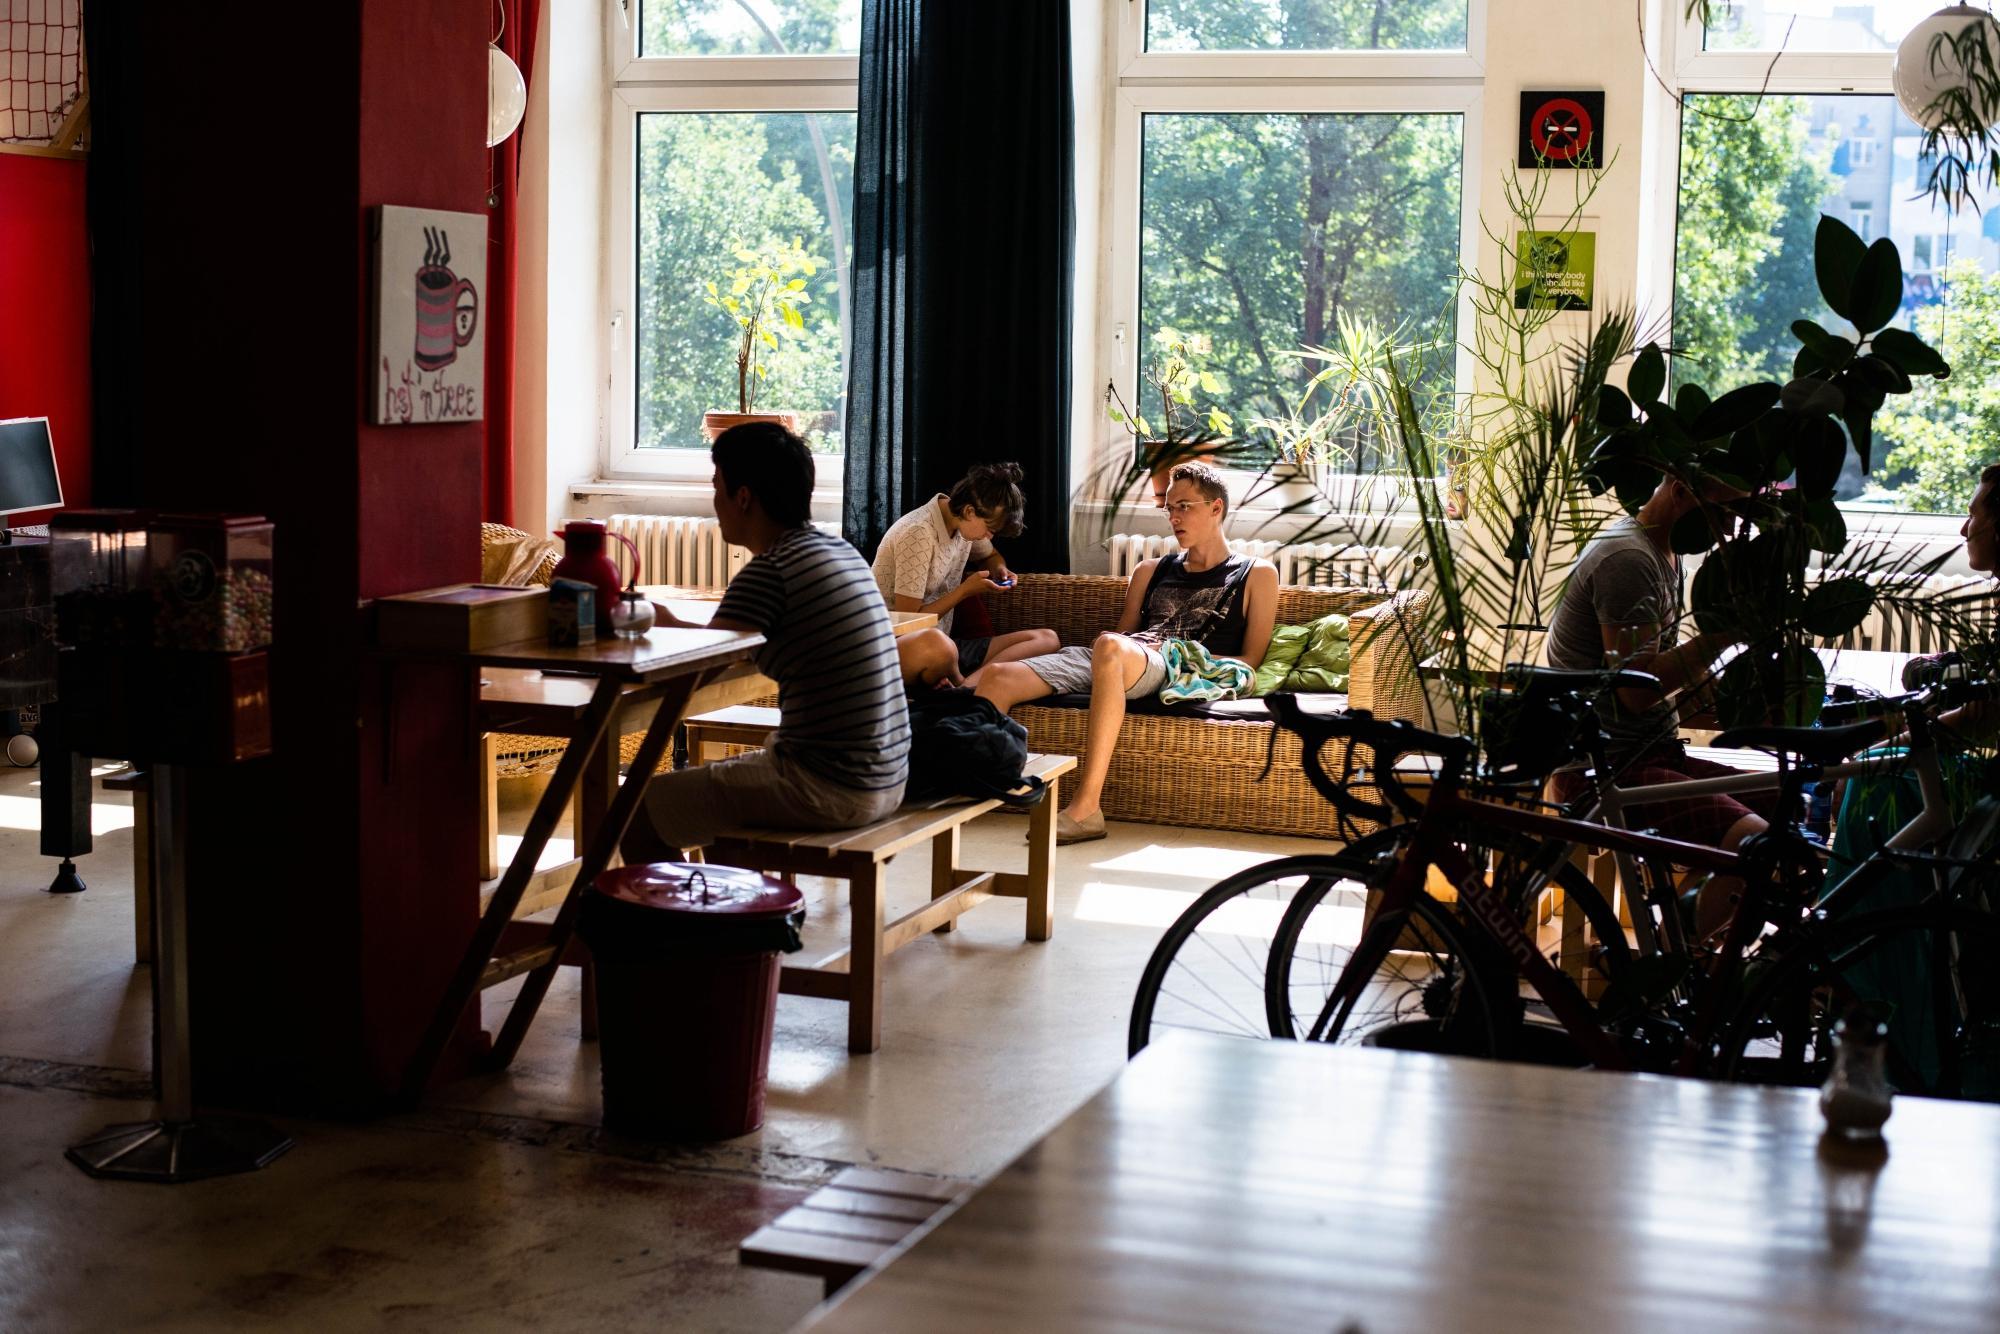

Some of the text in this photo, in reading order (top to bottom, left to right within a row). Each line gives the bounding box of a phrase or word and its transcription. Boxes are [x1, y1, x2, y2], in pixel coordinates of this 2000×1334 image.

[1525, 270, 1545, 278] thi
[1545, 271, 1586, 281] everbody
[1571, 279, 1585, 288] like
[1544, 287, 1585, 297] verybody.
